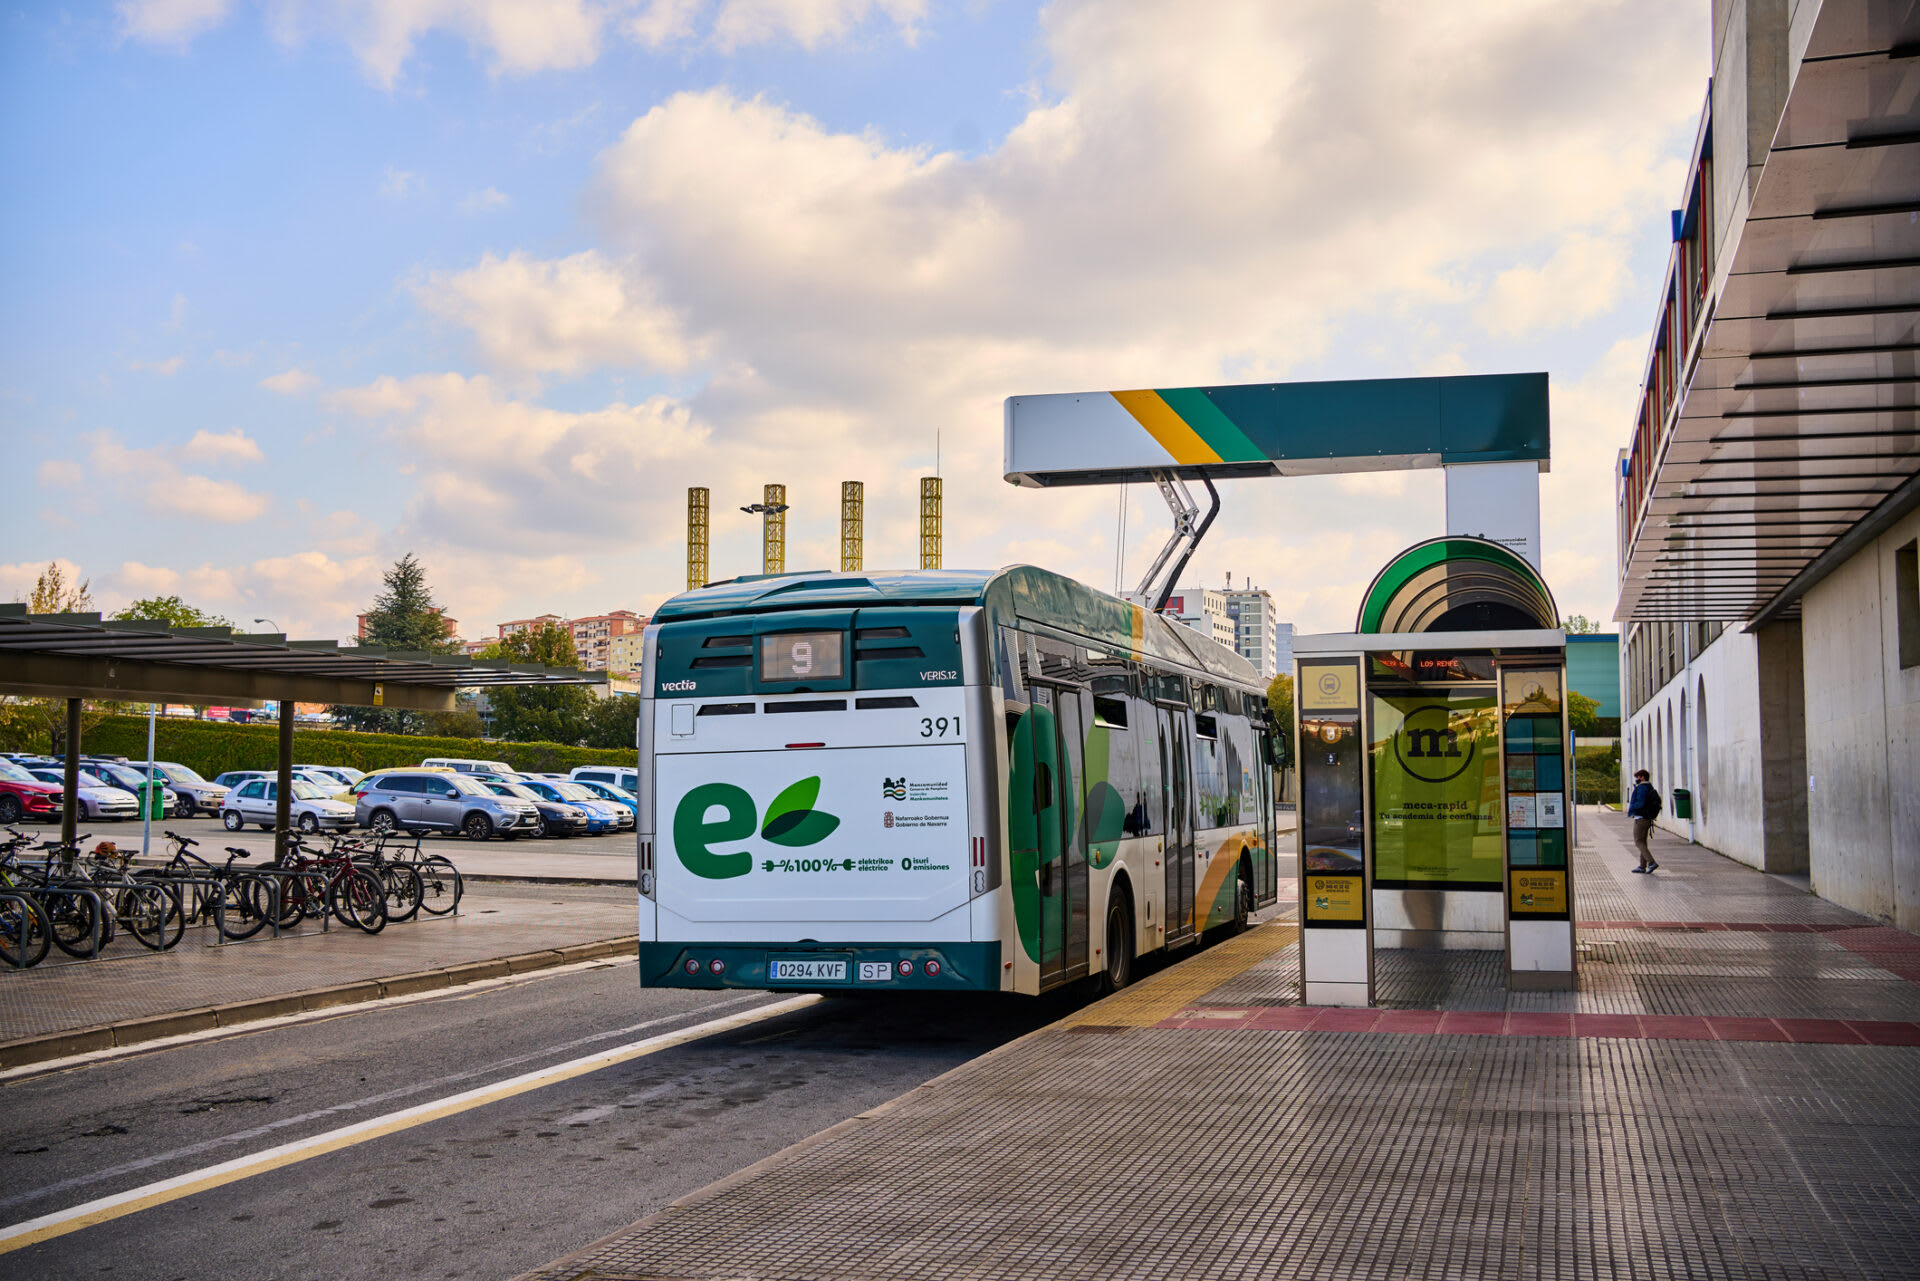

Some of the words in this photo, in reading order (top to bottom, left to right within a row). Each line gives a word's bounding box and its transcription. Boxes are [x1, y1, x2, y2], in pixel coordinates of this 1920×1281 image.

[791, 642, 813, 674] 9
[919, 670, 957, 681] VERIS.12
[661, 680, 697, 692] vectia
[919, 716, 961, 738] 391
[1406, 728, 1462, 758] m
[1402, 800, 1468, 811] meca-rapid
[1379, 812, 1390, 820] Tu
[1393, 812, 1434, 820] academia
[1436, 812, 1447, 820] de
[1449, 812, 1493, 820] confianza
[673, 782, 758, 880] e
[858, 864, 888, 872] eléctrico
[901, 857, 912, 871] 0
[913, 863, 950, 871] emisiones
[779, 963, 813, 977] 0294
[817, 963, 843, 977] KVF
